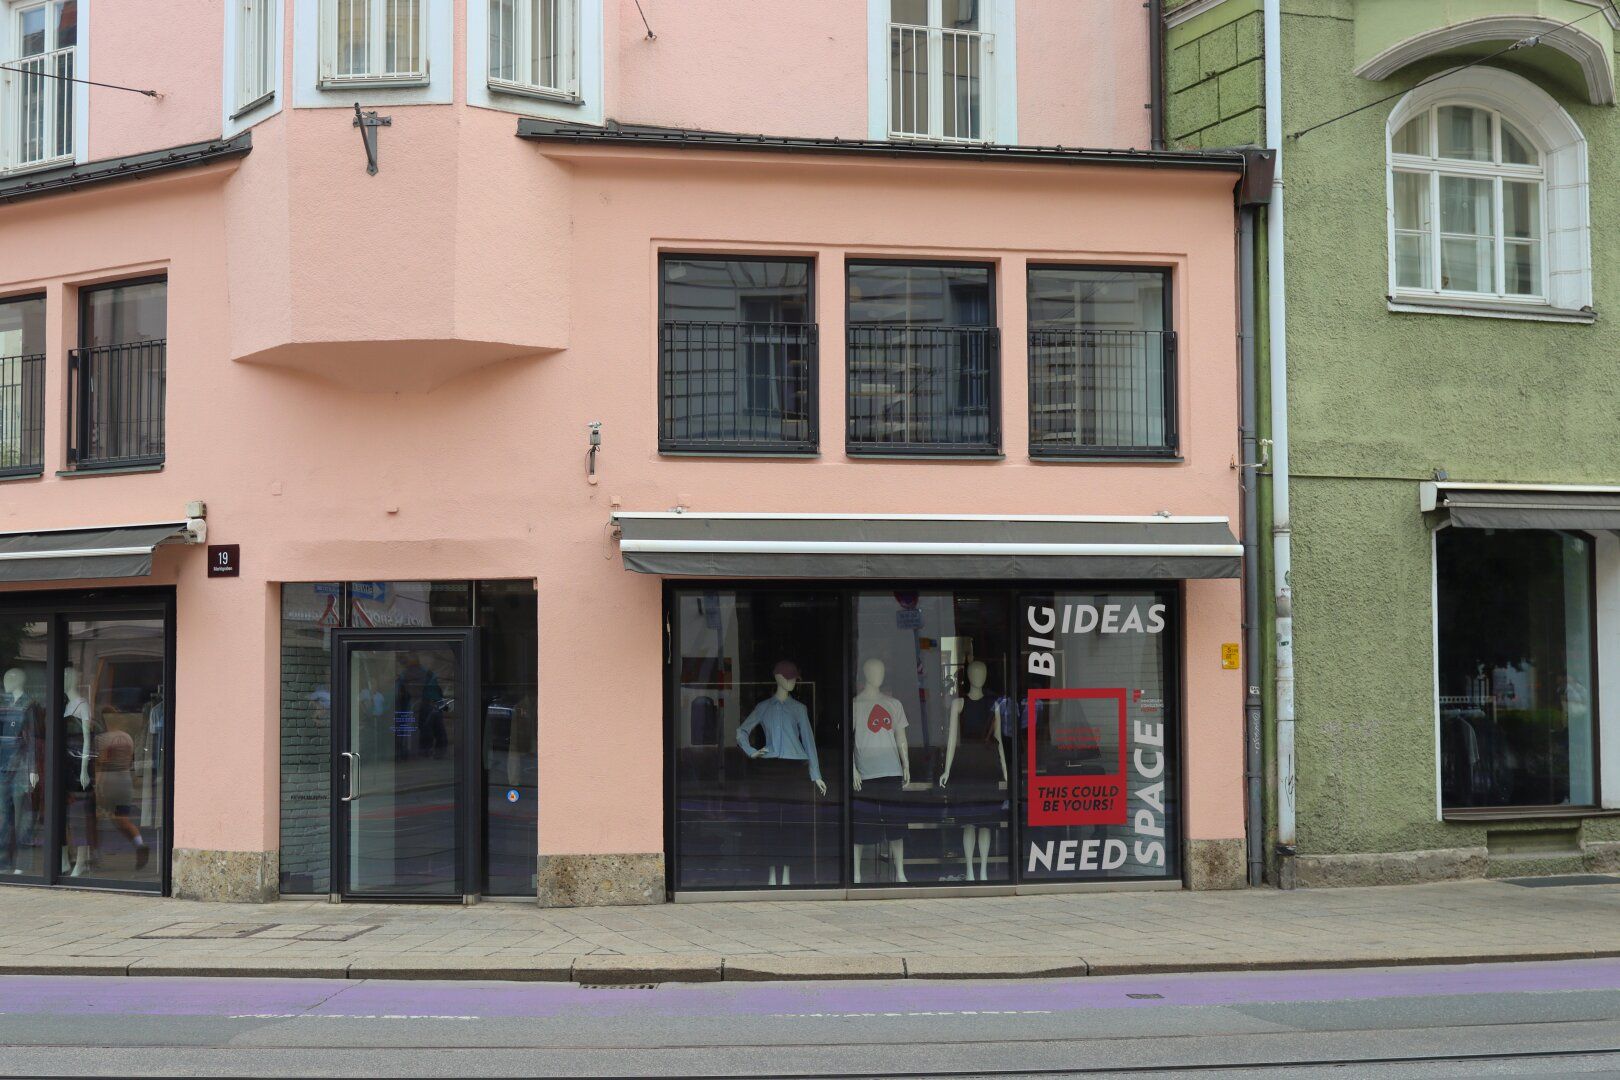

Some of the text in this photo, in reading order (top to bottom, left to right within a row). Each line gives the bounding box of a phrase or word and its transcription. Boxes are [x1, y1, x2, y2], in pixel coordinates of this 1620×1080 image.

[218, 551, 228, 565] 19
[1061, 604, 1166, 633] IDEAS
[1028, 606, 1055, 677] BIG
[1038, 785, 1119, 798] THIS COULD
[1043, 799, 1114, 812] BE YOURS!
[1133, 720, 1165, 867] SPACE
[1028, 839, 1128, 872] NEED
